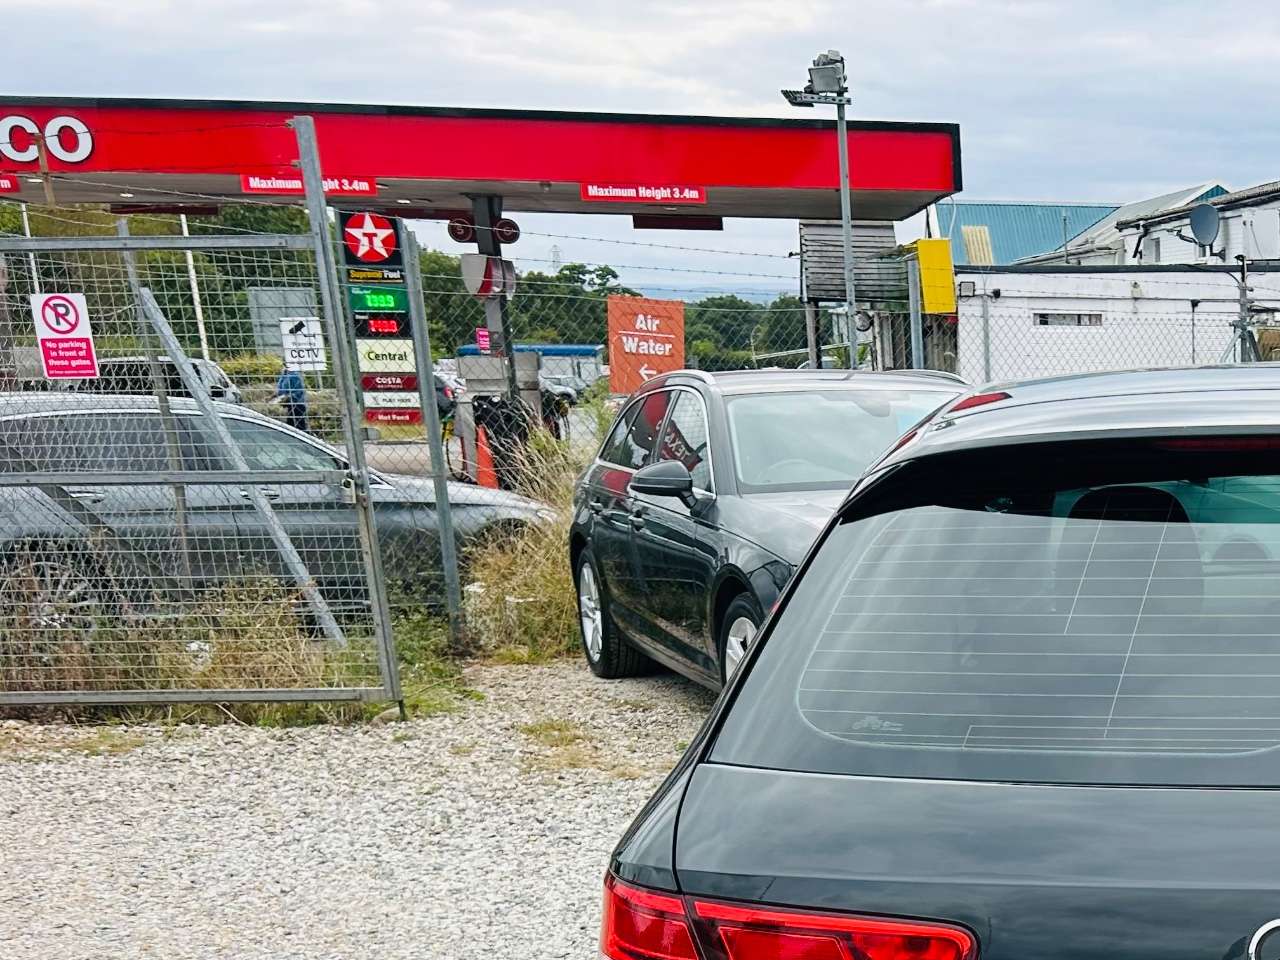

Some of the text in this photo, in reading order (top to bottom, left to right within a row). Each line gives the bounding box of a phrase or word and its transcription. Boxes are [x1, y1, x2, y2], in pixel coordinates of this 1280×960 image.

[248, 176, 303, 189] Maximum
[341, 179, 370, 191] 3.4m
[587, 185, 699, 199] Maximum Height 3.4m
[635, 313, 660, 331] Air
[58, 340, 87, 349] parking
[621, 336, 673, 356] Water
[290, 349, 320, 359] CCTV
[367, 351, 408, 361] Central
